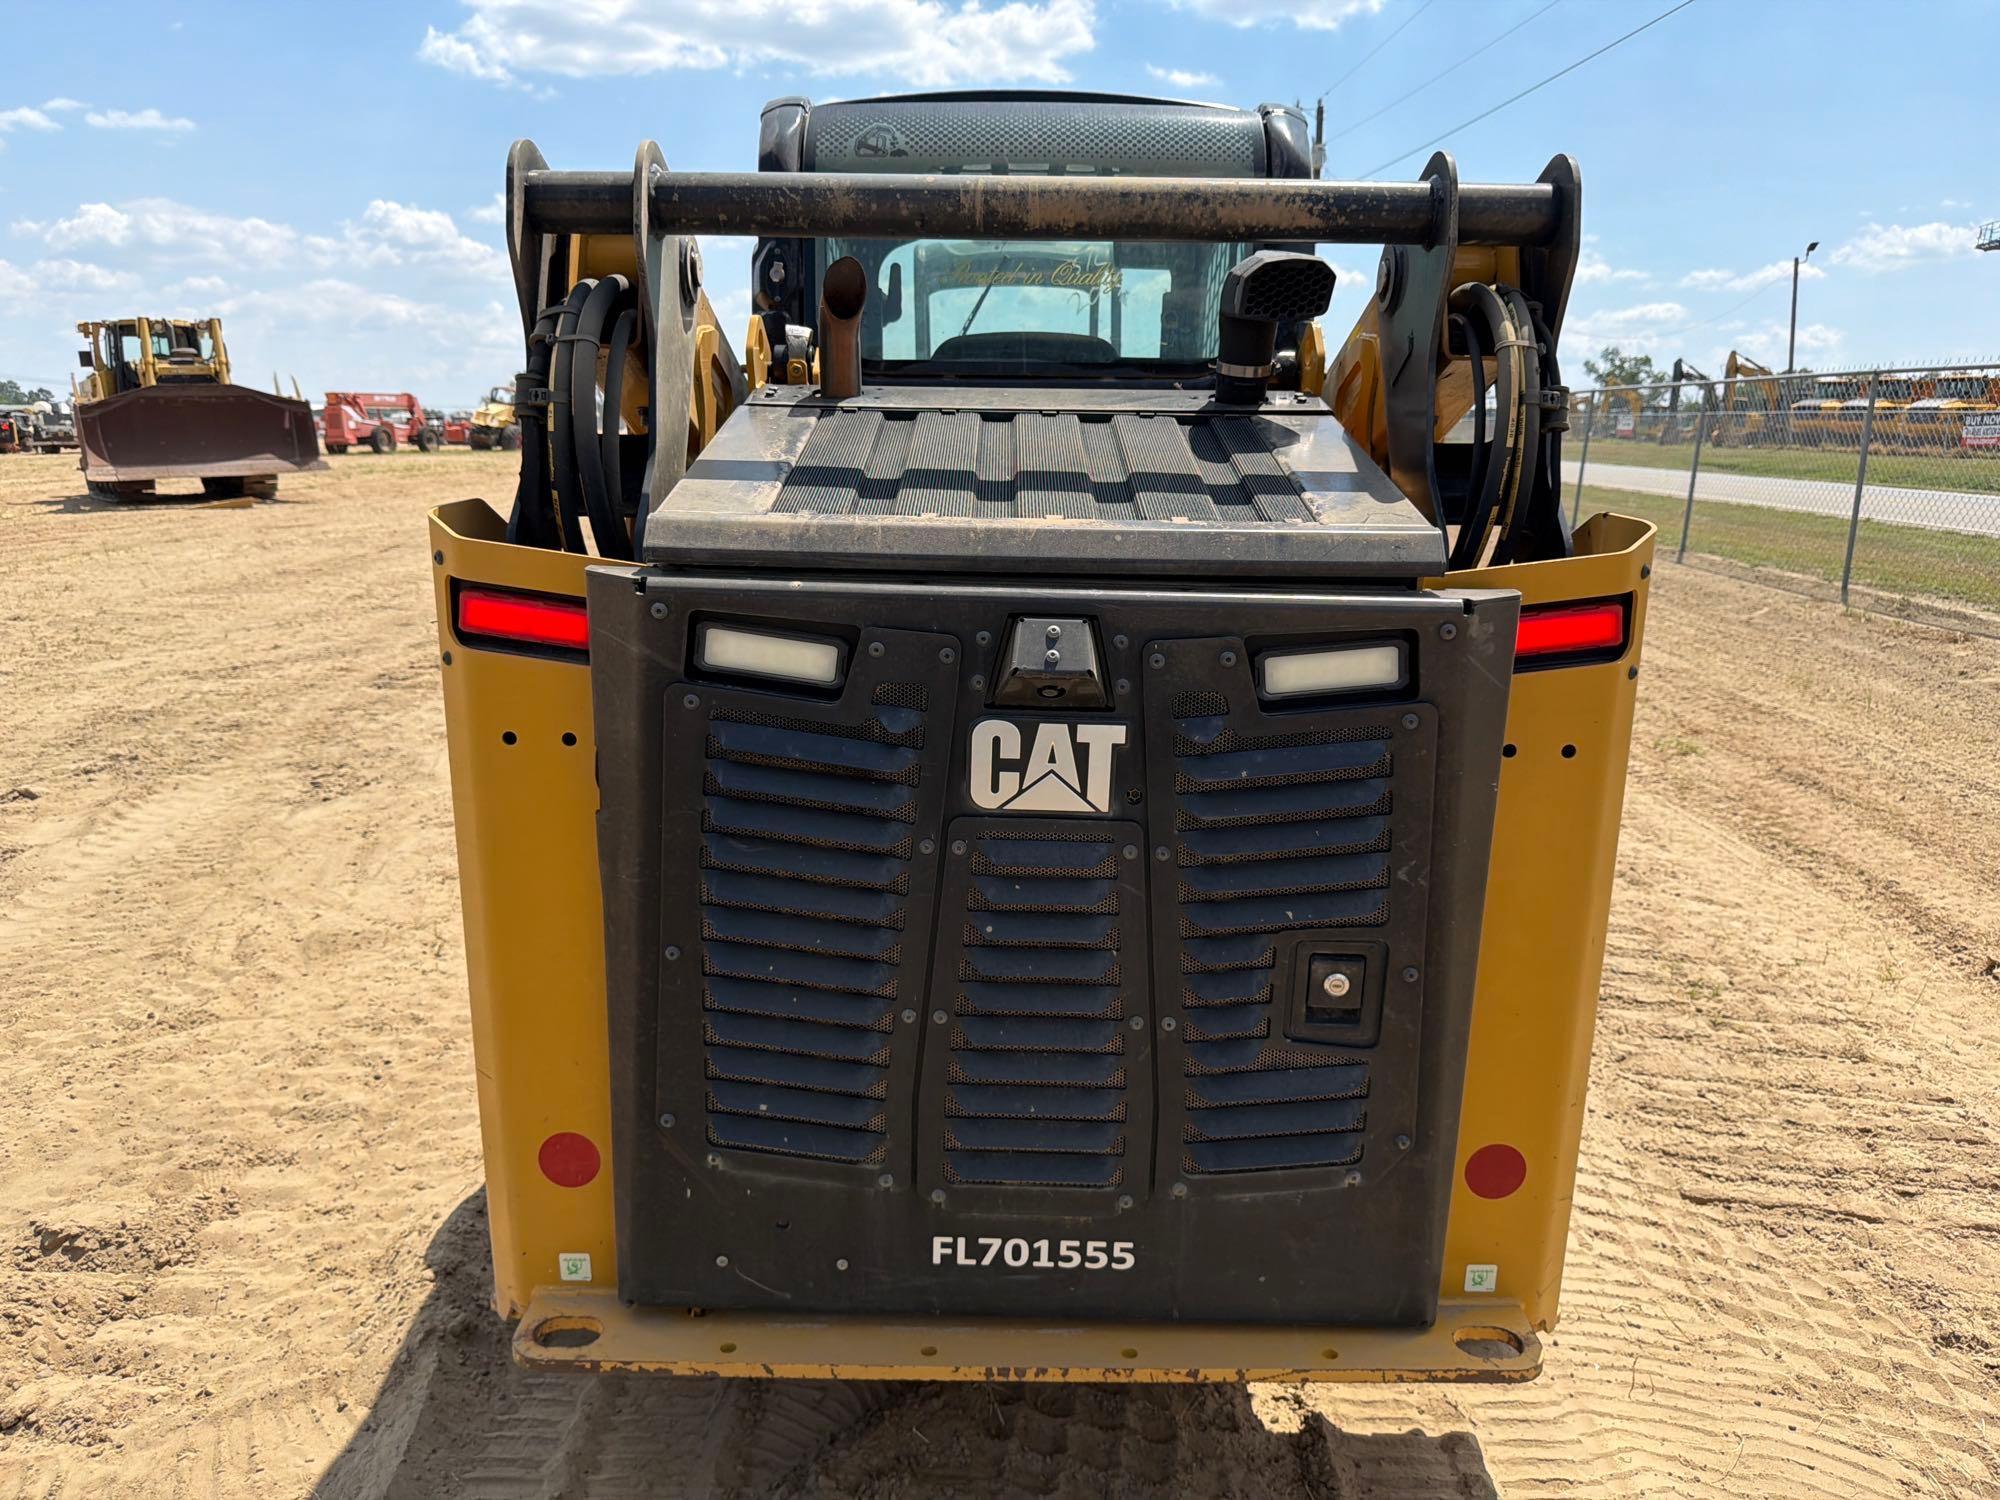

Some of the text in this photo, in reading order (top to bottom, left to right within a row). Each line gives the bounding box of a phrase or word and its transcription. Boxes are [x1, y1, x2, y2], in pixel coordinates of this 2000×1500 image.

[1023, 266, 1044, 284] in
[1051, 260, 1122, 293] Quality
[1965, 415, 1982, 425] BUY
[970, 719, 1127, 813] CAT
[932, 1236, 1136, 1270] FL701555
